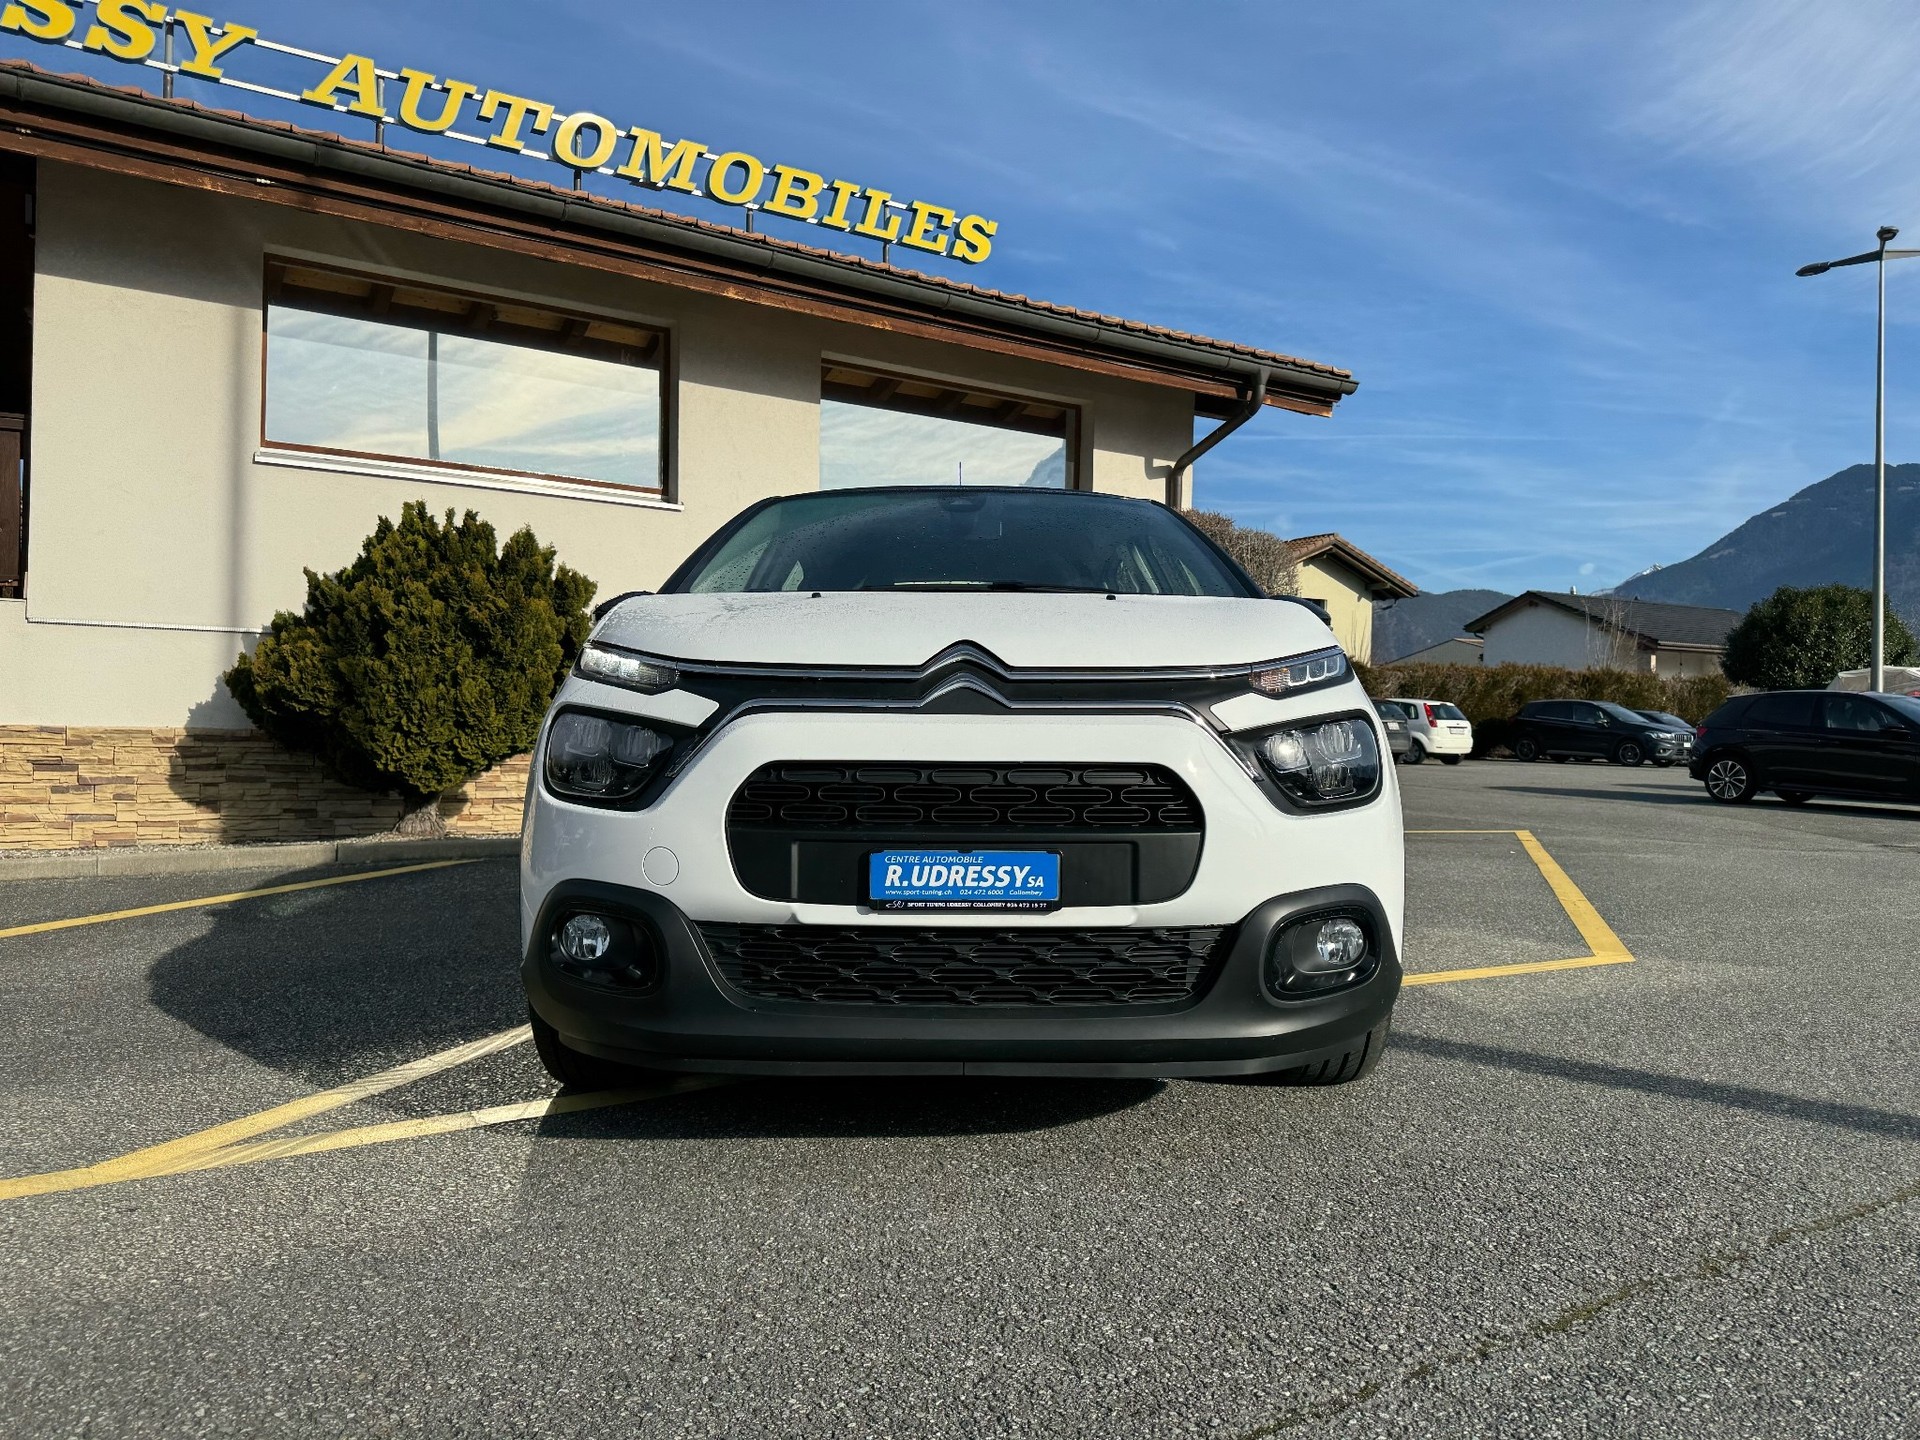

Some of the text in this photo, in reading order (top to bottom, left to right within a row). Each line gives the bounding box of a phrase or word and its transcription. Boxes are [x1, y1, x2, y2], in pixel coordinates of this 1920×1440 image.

[302, 53, 999, 264] AUTOMOBILES
[885, 865, 1044, 887] R.UDRESSY SA
[885, 889, 952, 897] www.sport-tuning.ch
[1009, 889, 1043, 897] Collombey
